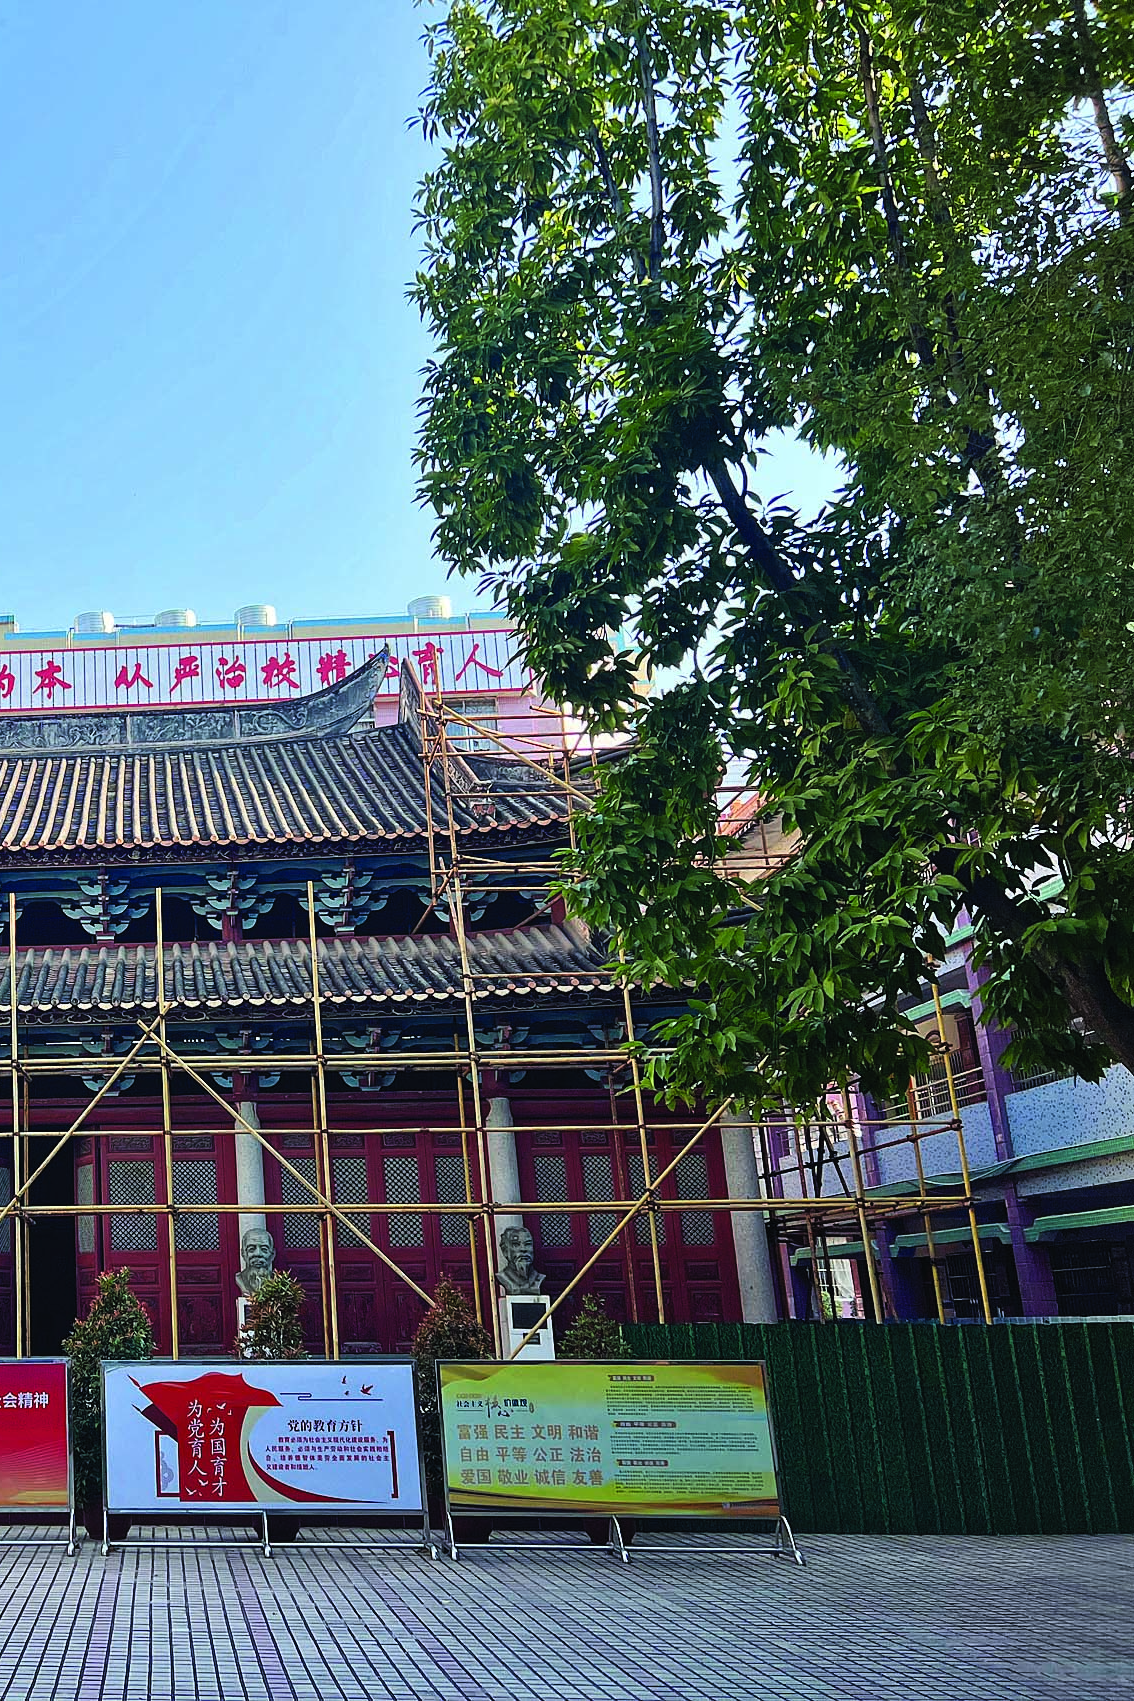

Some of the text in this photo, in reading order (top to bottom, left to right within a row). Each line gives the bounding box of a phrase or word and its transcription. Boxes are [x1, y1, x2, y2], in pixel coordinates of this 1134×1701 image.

[287, 1419, 364, 1433] 党的教育方针
[457, 1424, 599, 1442] 富强 民主 文明 和谐
[187, 1398, 208, 1477] 为党育人
[209, 1419, 229, 1498] 为国育才
[460, 1446, 602, 1464] 自由 平等 公正 法治
[460, 1469, 491, 1486] 爱国
[497, 1468, 529, 1486] 敬业
[535, 1469, 566, 1486] 诚信
[572, 1469, 604, 1487] 友善
